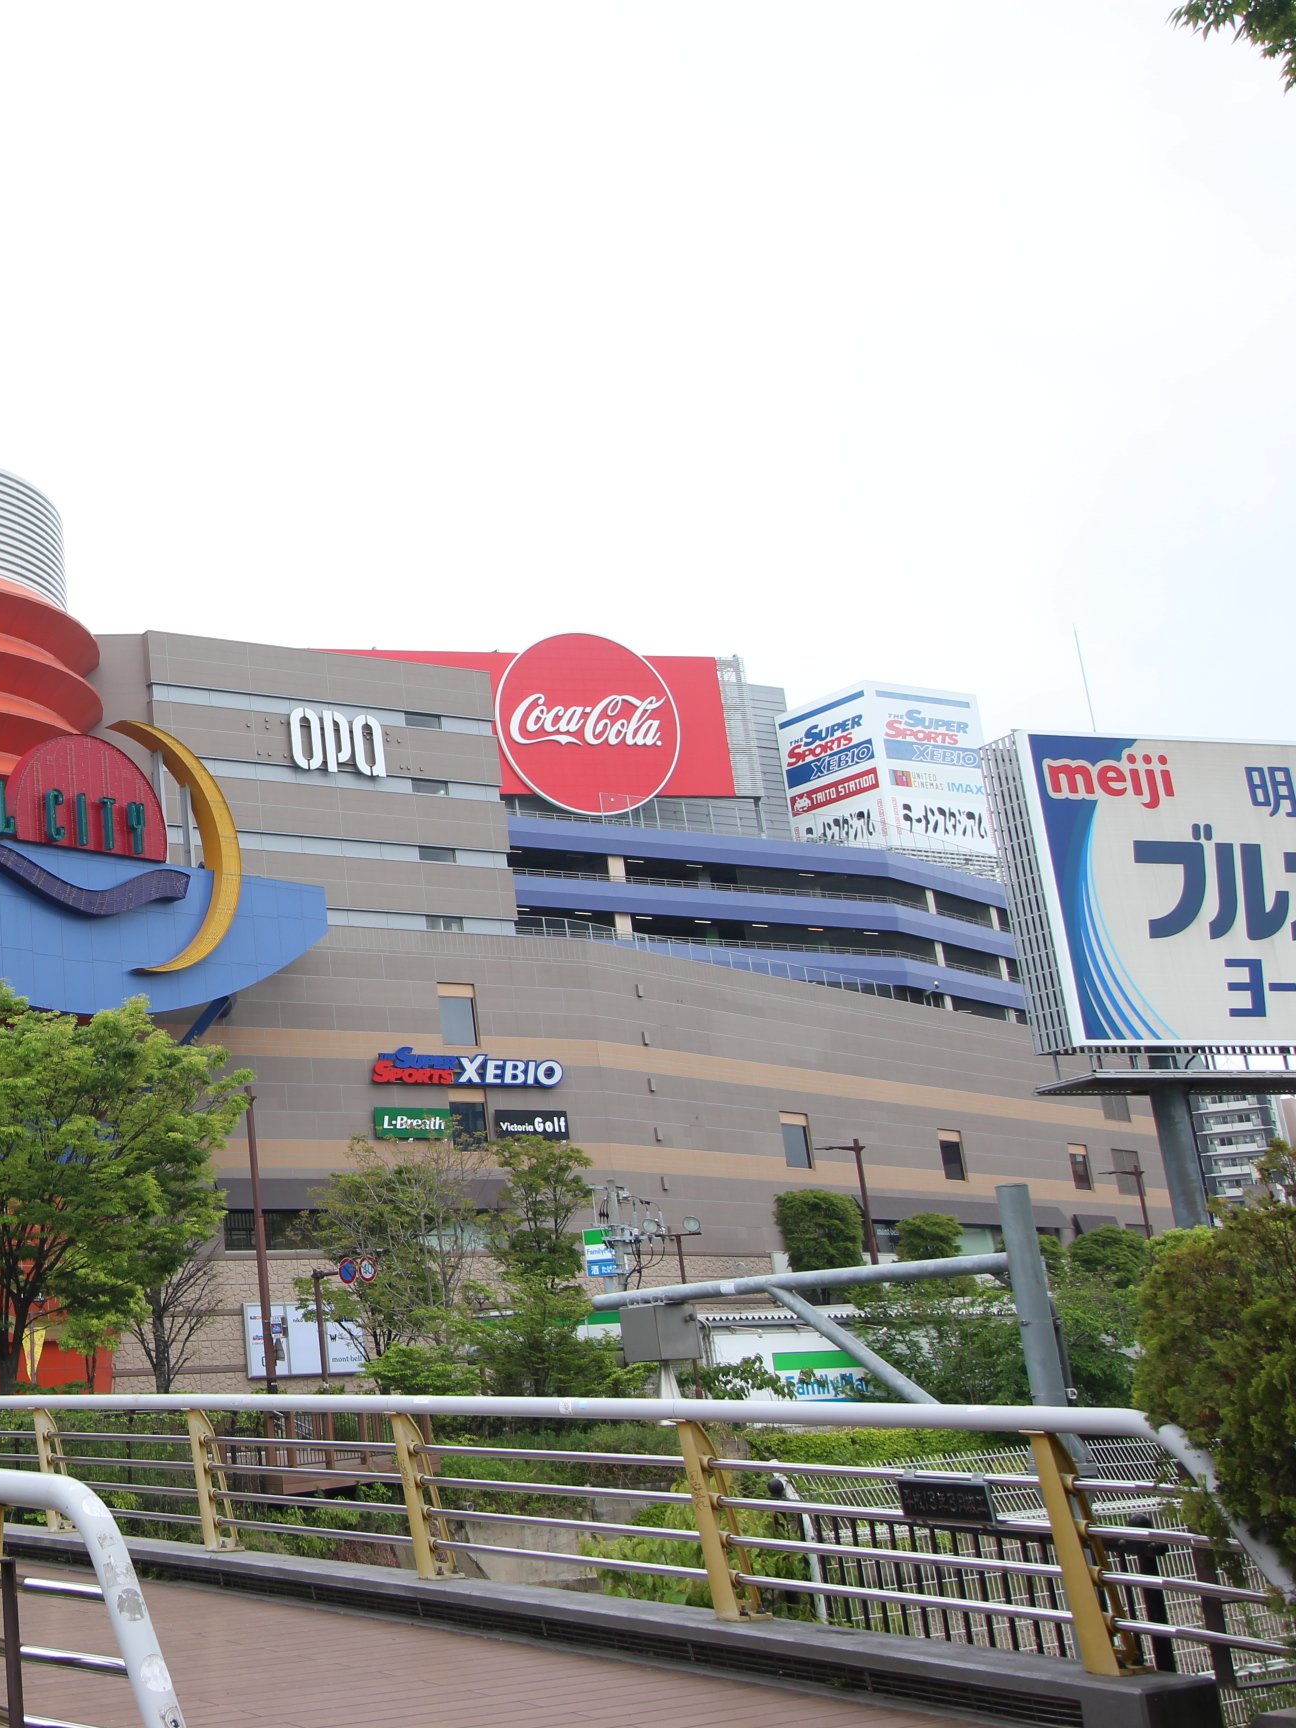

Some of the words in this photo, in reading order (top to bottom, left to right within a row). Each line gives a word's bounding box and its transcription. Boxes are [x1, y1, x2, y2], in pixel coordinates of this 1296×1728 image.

[510, 693, 666, 747] Coca-Cola
[803, 714, 863, 748] SUPER
[885, 719, 959, 746] SPORTS
[904, 709, 968, 734] SUPER
[787, 732, 853, 767] SPORTS
[810, 744, 872, 780] XEBIO
[912, 744, 979, 767] XEBIO
[812, 786, 837, 805] TAITO
[838, 773, 876, 796] STATION
[947, 782, 985, 796] IMAX
[1047, 753, 1175, 810] meiji
[44, 788, 145, 855] CITY
[1133, 823, 1296, 941] ブル
[372, 1059, 455, 1085] SPORTS
[457, 1054, 564, 1087] XEBIO
[393, 1046, 457, 1070] SUPER
[383, 1115, 445, 1131] L-Breath
[500, 1121, 534, 1132] Victoria
[533, 1116, 567, 1133] Golf
